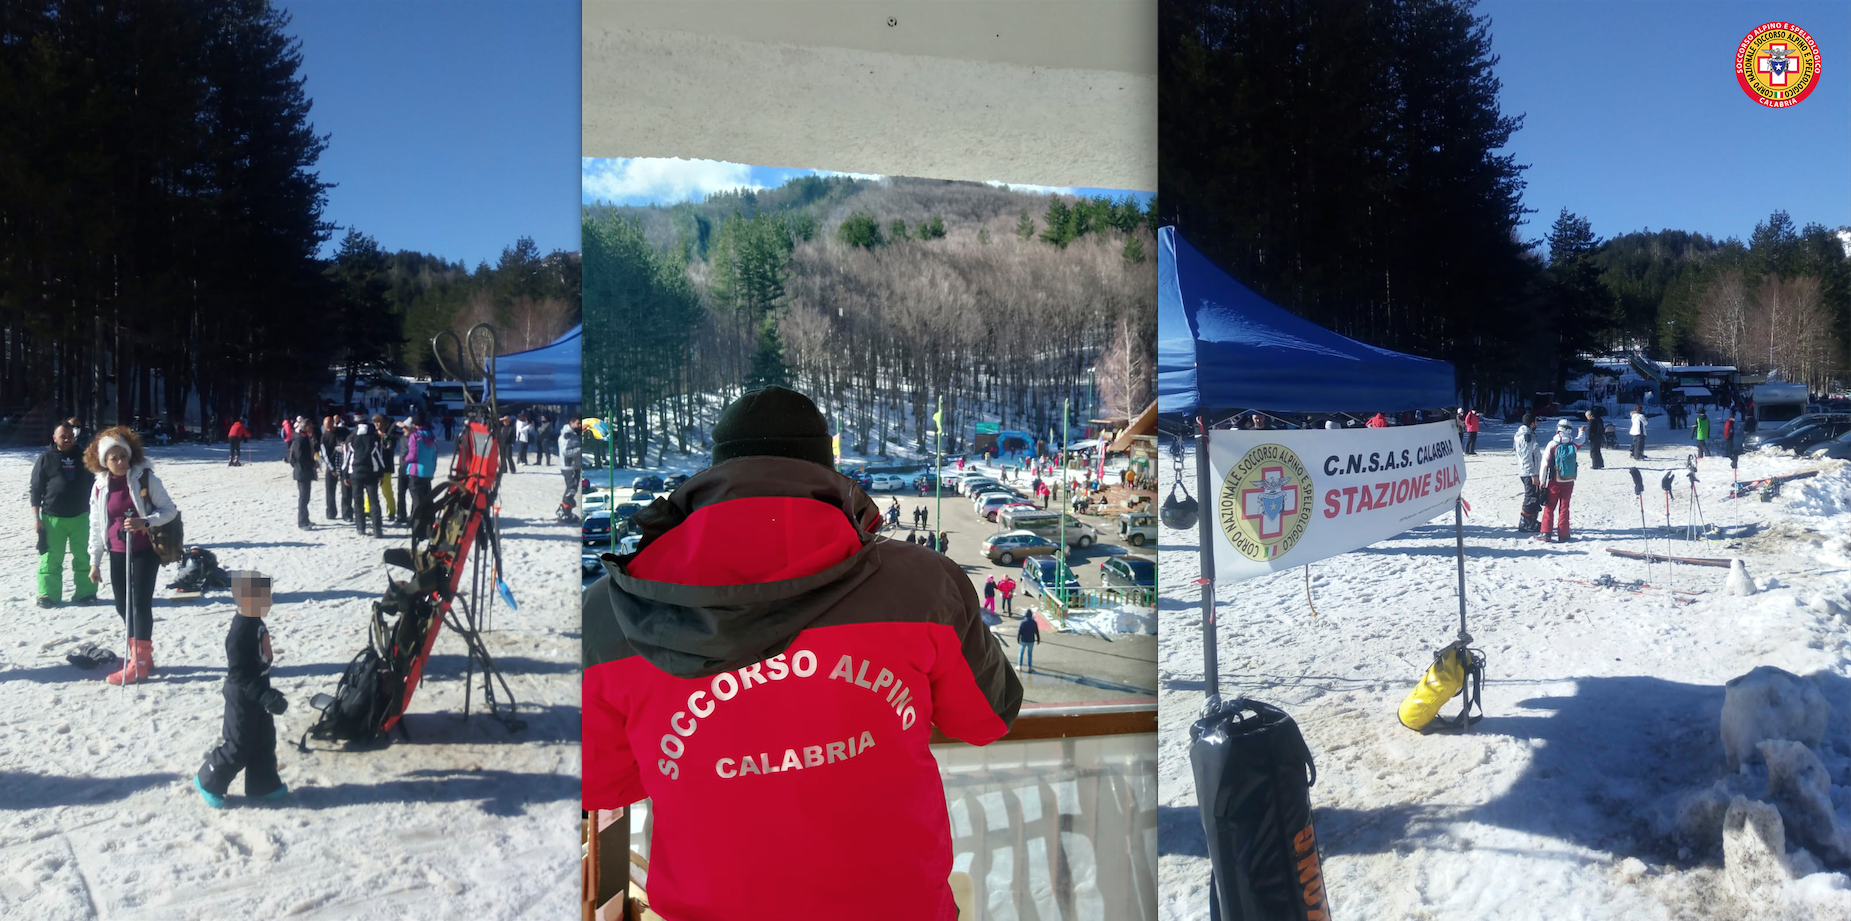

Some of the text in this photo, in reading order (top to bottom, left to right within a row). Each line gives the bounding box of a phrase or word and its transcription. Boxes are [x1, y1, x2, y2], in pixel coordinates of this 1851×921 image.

[1324, 439, 1454, 476] C.N.S.A.S. CALABRIA
[1221, 446, 1312, 558] CORPO NAZIONALE SOCCORSO ALPINO E SPELEOLOGICO
[1323, 473, 1432, 519] STAZIONE
[1435, 464, 1460, 493] SILA
[657, 649, 916, 781] SOCCORSO ALPINO
[715, 730, 876, 779] CALABRIA
